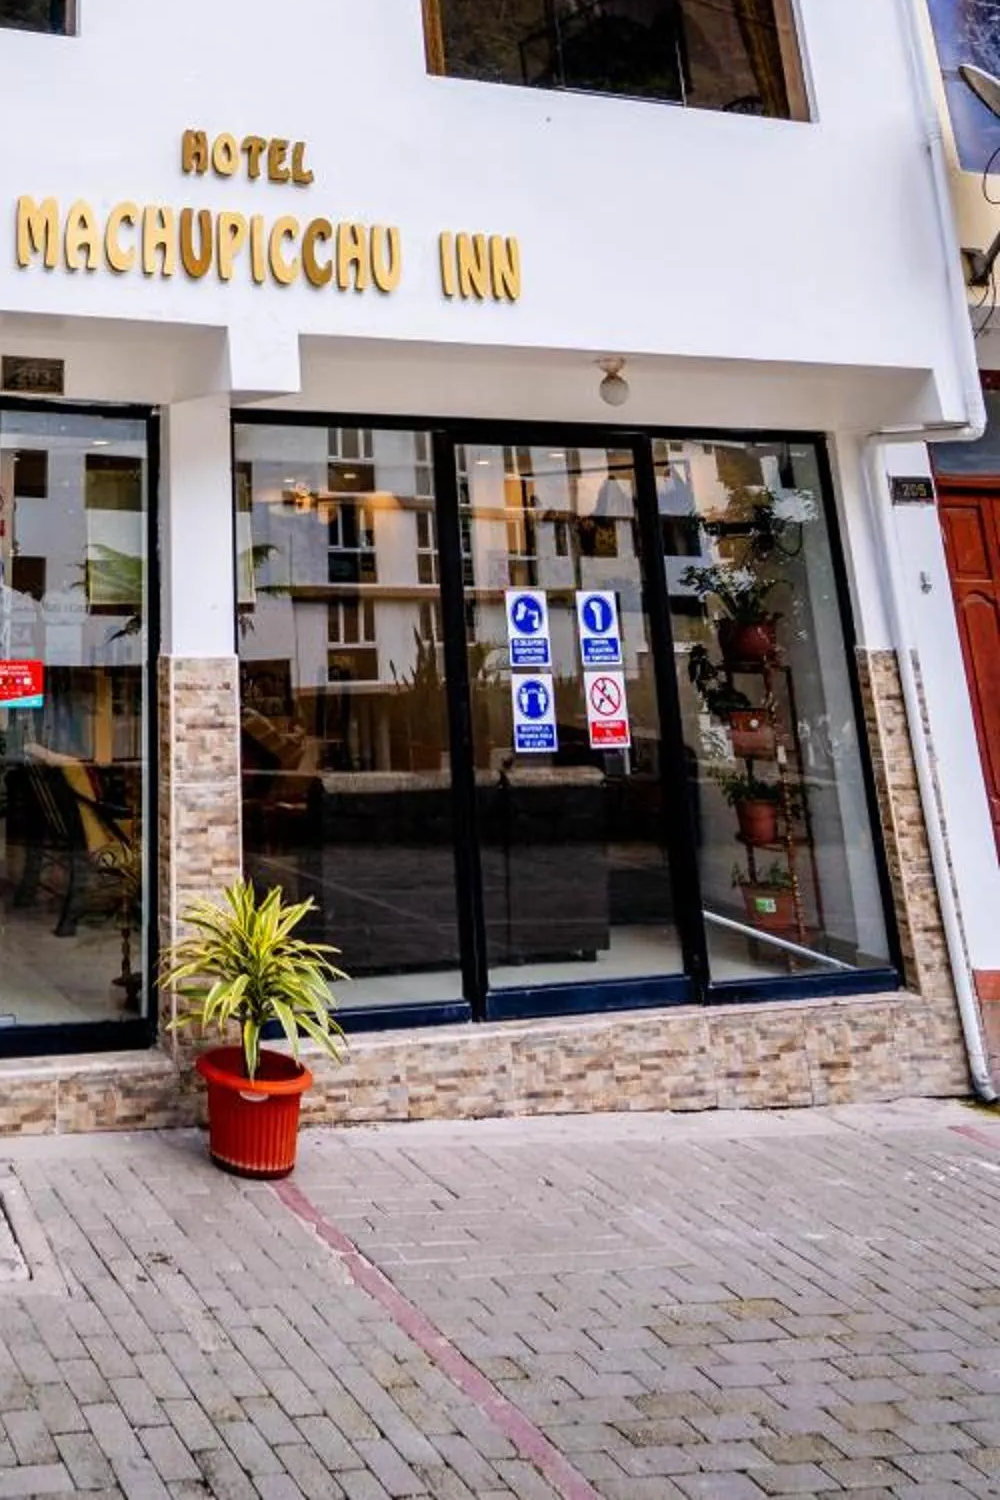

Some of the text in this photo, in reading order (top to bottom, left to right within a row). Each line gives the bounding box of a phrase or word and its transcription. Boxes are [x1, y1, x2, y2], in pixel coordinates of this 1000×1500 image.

[182, 129, 315, 185] HOTEL
[15, 195, 522, 300] MACHUPICCHU INN
